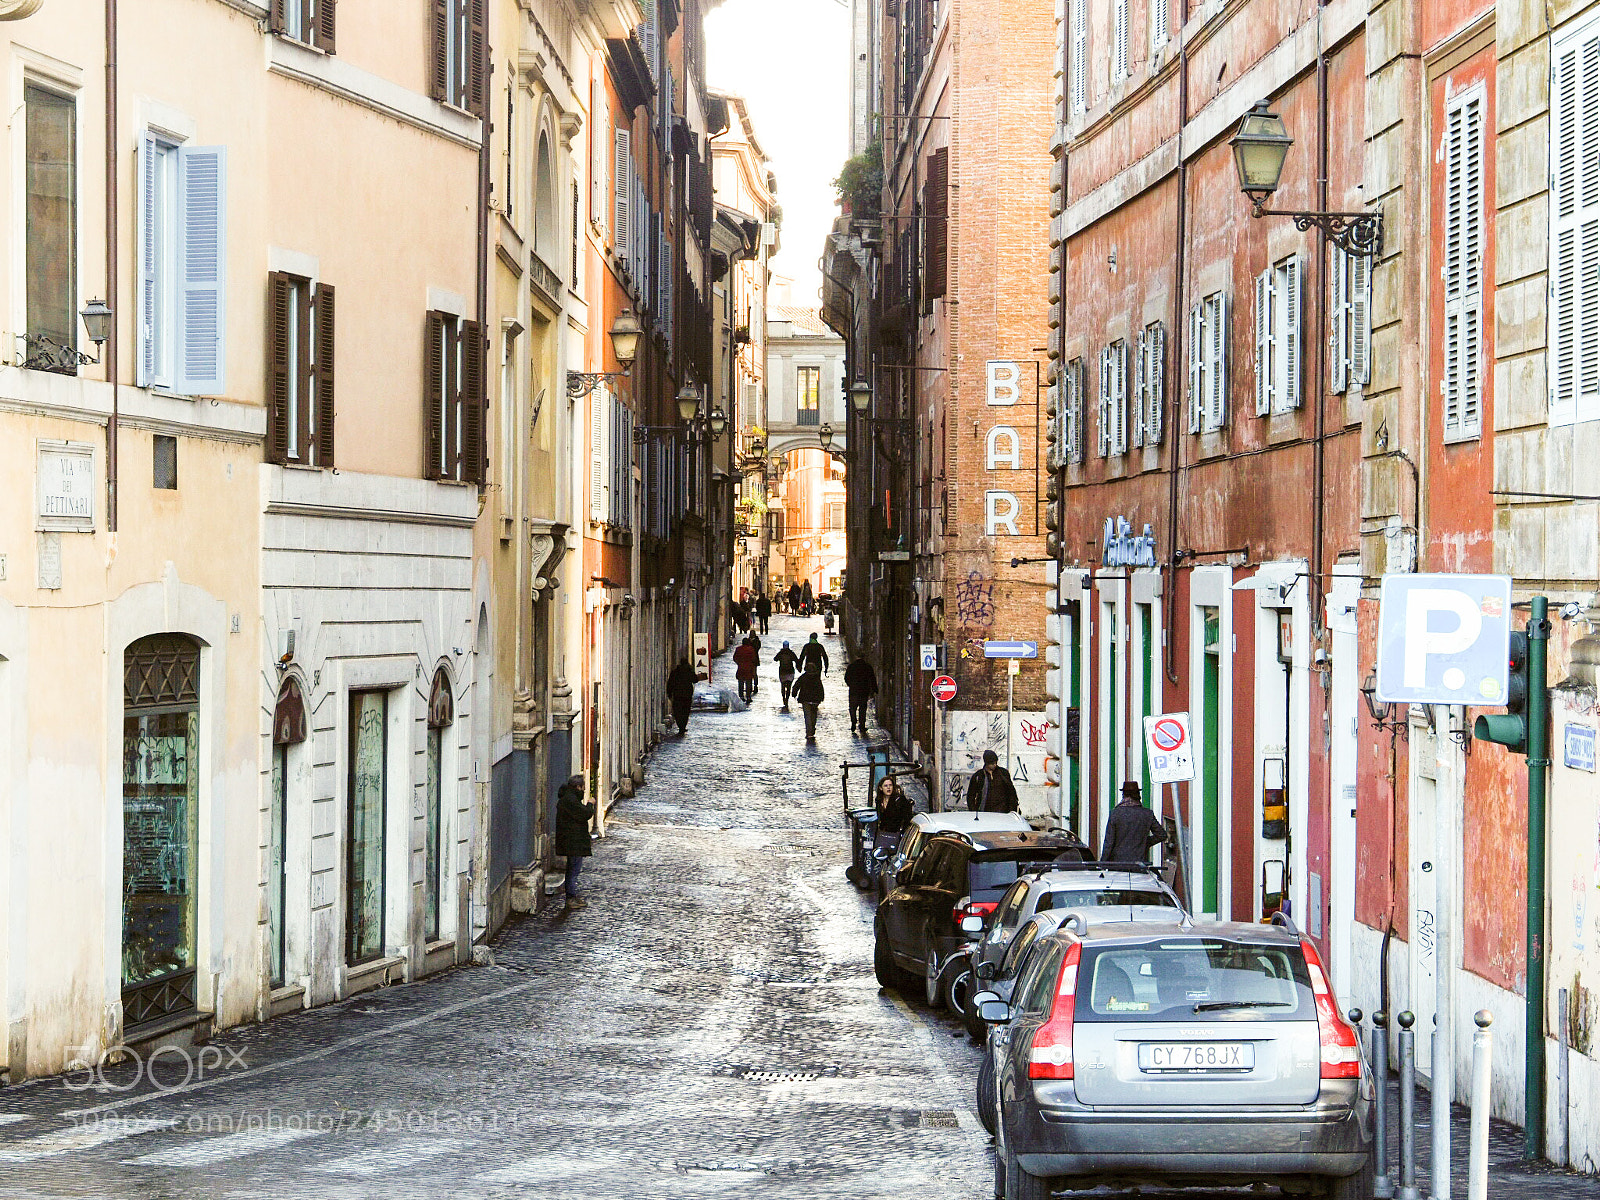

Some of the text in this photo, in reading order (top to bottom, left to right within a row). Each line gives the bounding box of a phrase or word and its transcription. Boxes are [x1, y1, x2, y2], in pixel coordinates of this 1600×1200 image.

[985, 361, 1022, 536] BAR
[60, 458, 74, 476] VIA
[62, 480, 72, 493] DEI
[45, 495, 88, 514] PETTINARI
[1153, 1046, 1240, 1065] CY 768JX
